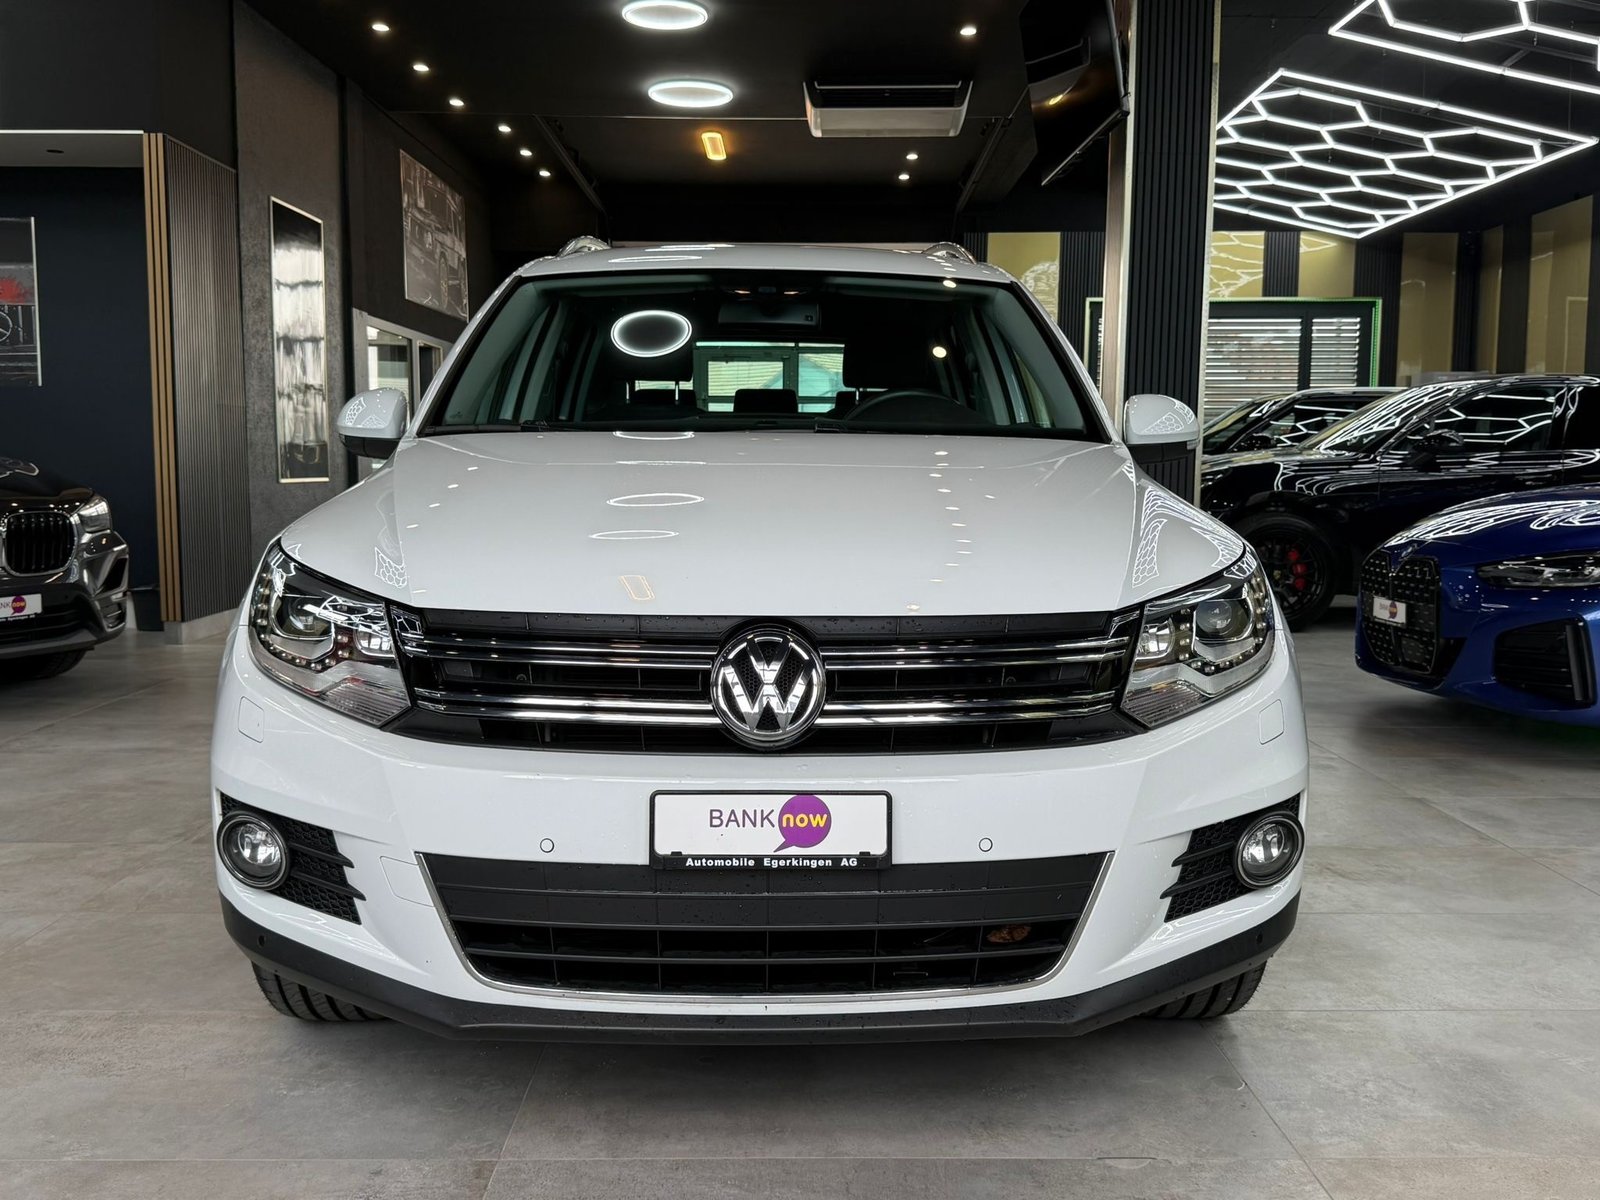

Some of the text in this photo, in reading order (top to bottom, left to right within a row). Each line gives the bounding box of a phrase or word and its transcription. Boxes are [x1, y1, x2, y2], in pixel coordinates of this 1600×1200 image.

[709, 808, 828, 828] BANK now
[685, 857, 858, 868] Automobile Egerkingen AG
